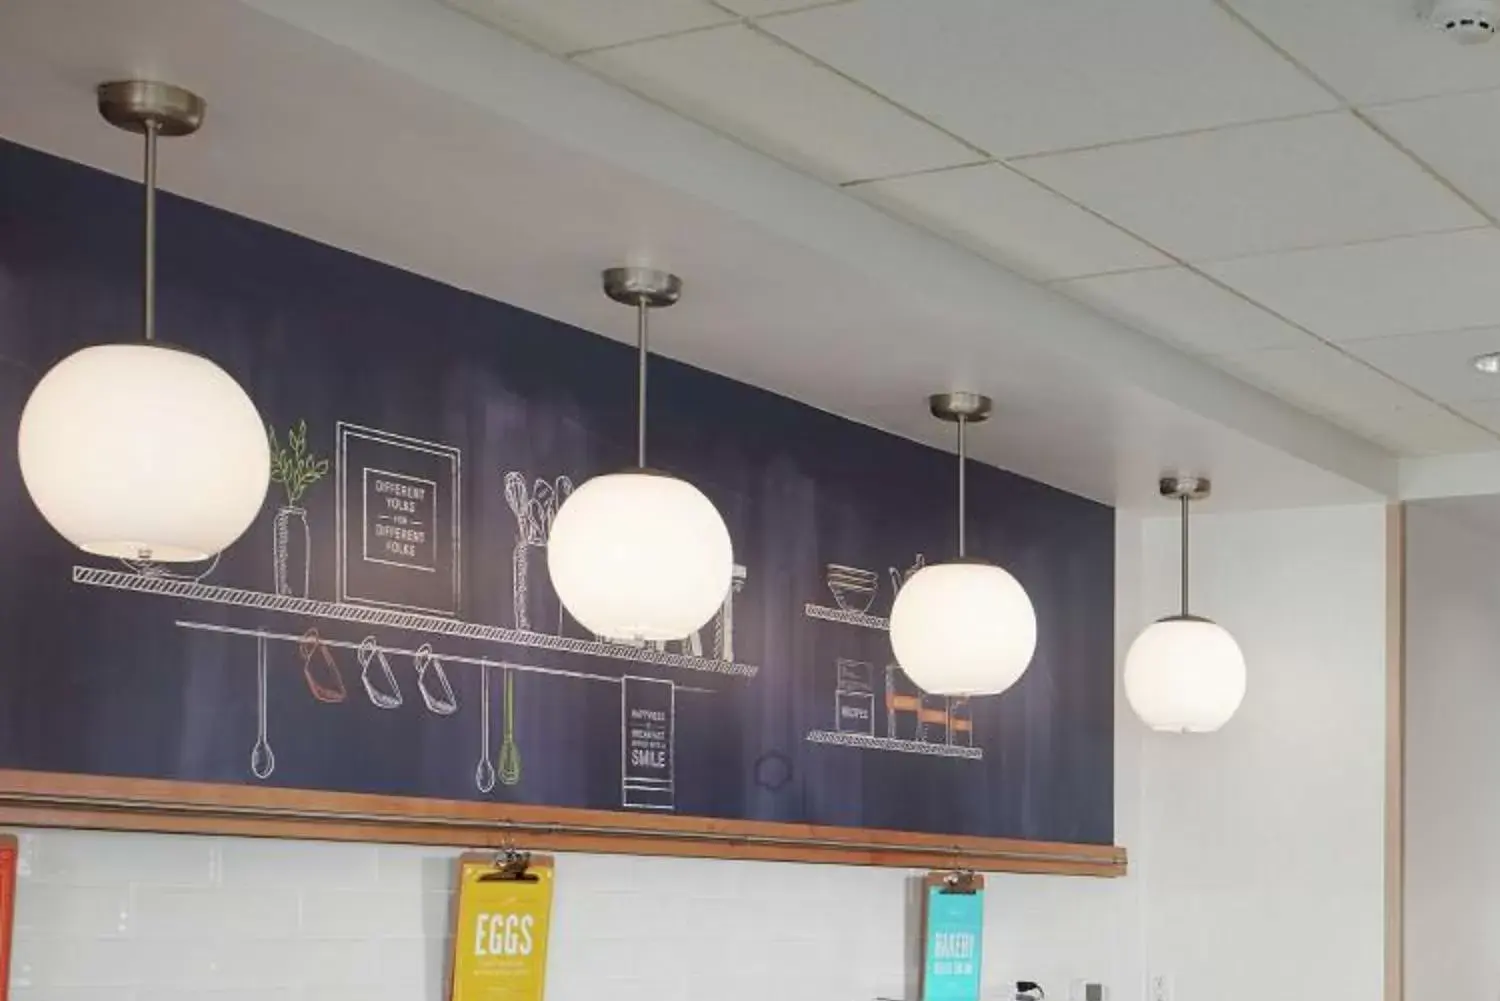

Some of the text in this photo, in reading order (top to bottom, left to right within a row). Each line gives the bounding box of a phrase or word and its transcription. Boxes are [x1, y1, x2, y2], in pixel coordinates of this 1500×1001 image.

[375, 480, 425, 499] DIFFERENT
[385, 497, 415, 513] YOLKS
[375, 523, 425, 543] DIFFERENT
[386, 541, 415, 557] FOLKS
[631, 750, 666, 768] SMILE
[475, 912, 534, 957] EGGS
